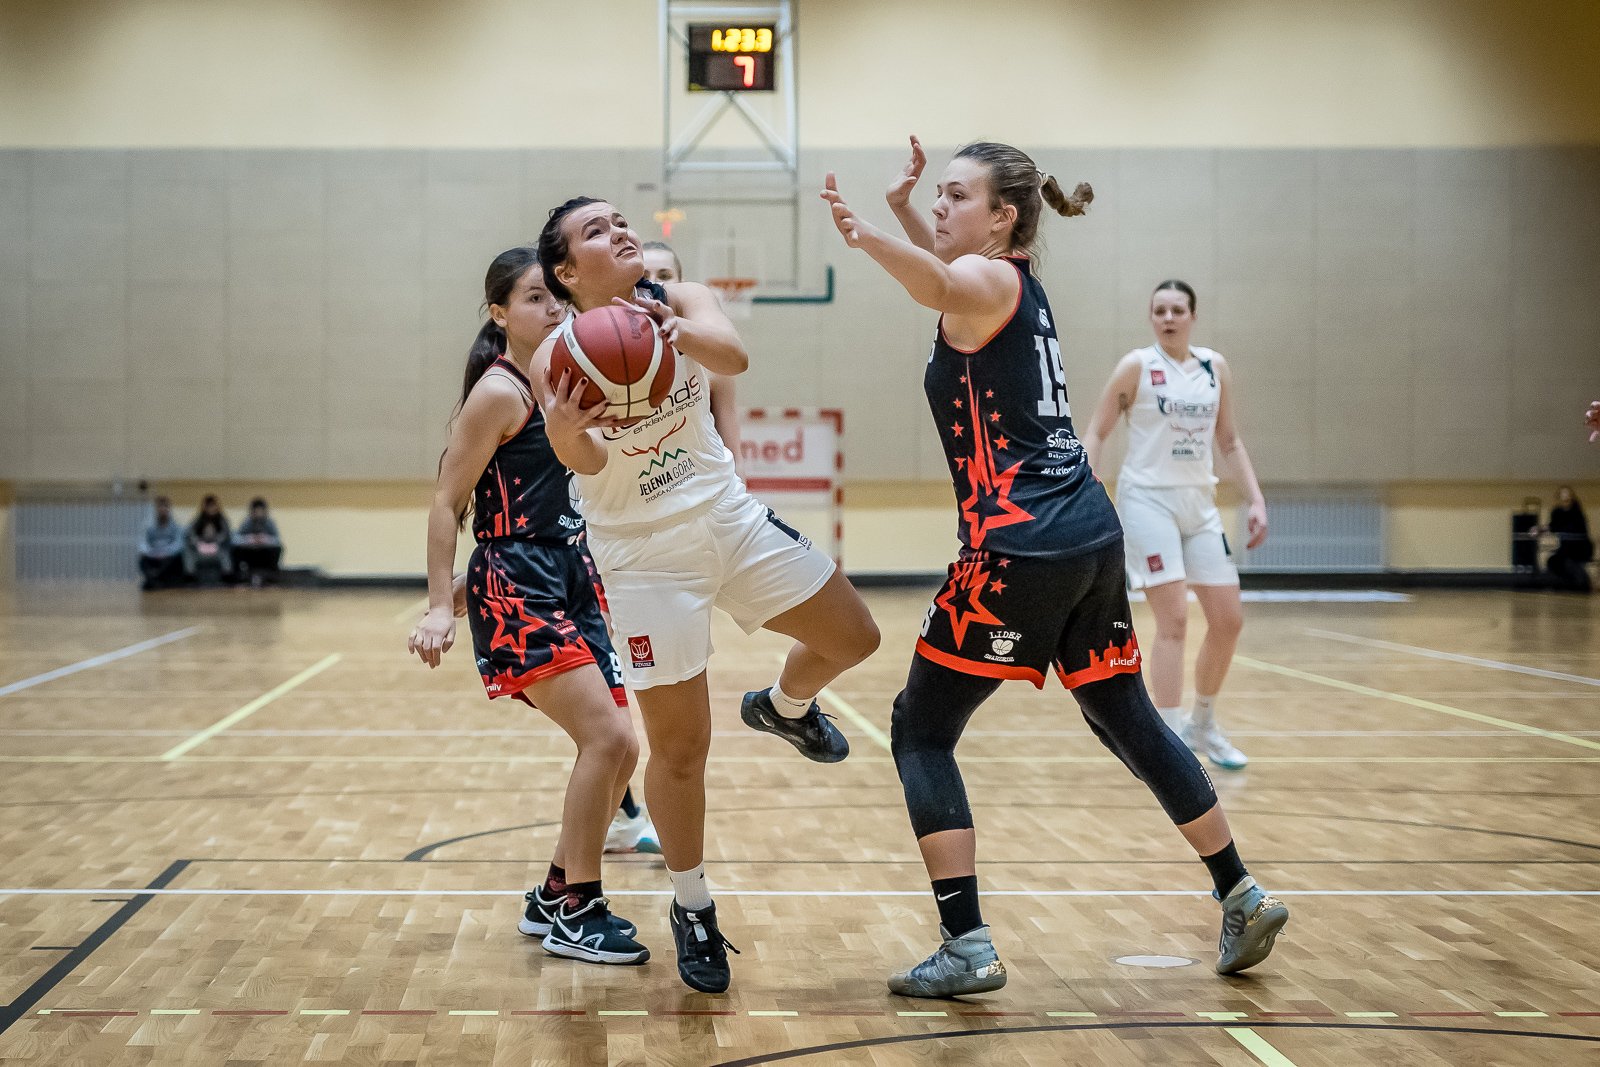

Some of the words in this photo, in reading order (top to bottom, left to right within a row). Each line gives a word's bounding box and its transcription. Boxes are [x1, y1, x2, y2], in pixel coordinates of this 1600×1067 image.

[734, 56, 755, 87] 7
[633, 410, 674, 435] enklawa
[640, 471, 674, 497] JELENIA
[989, 630, 1022, 642] LIDER
